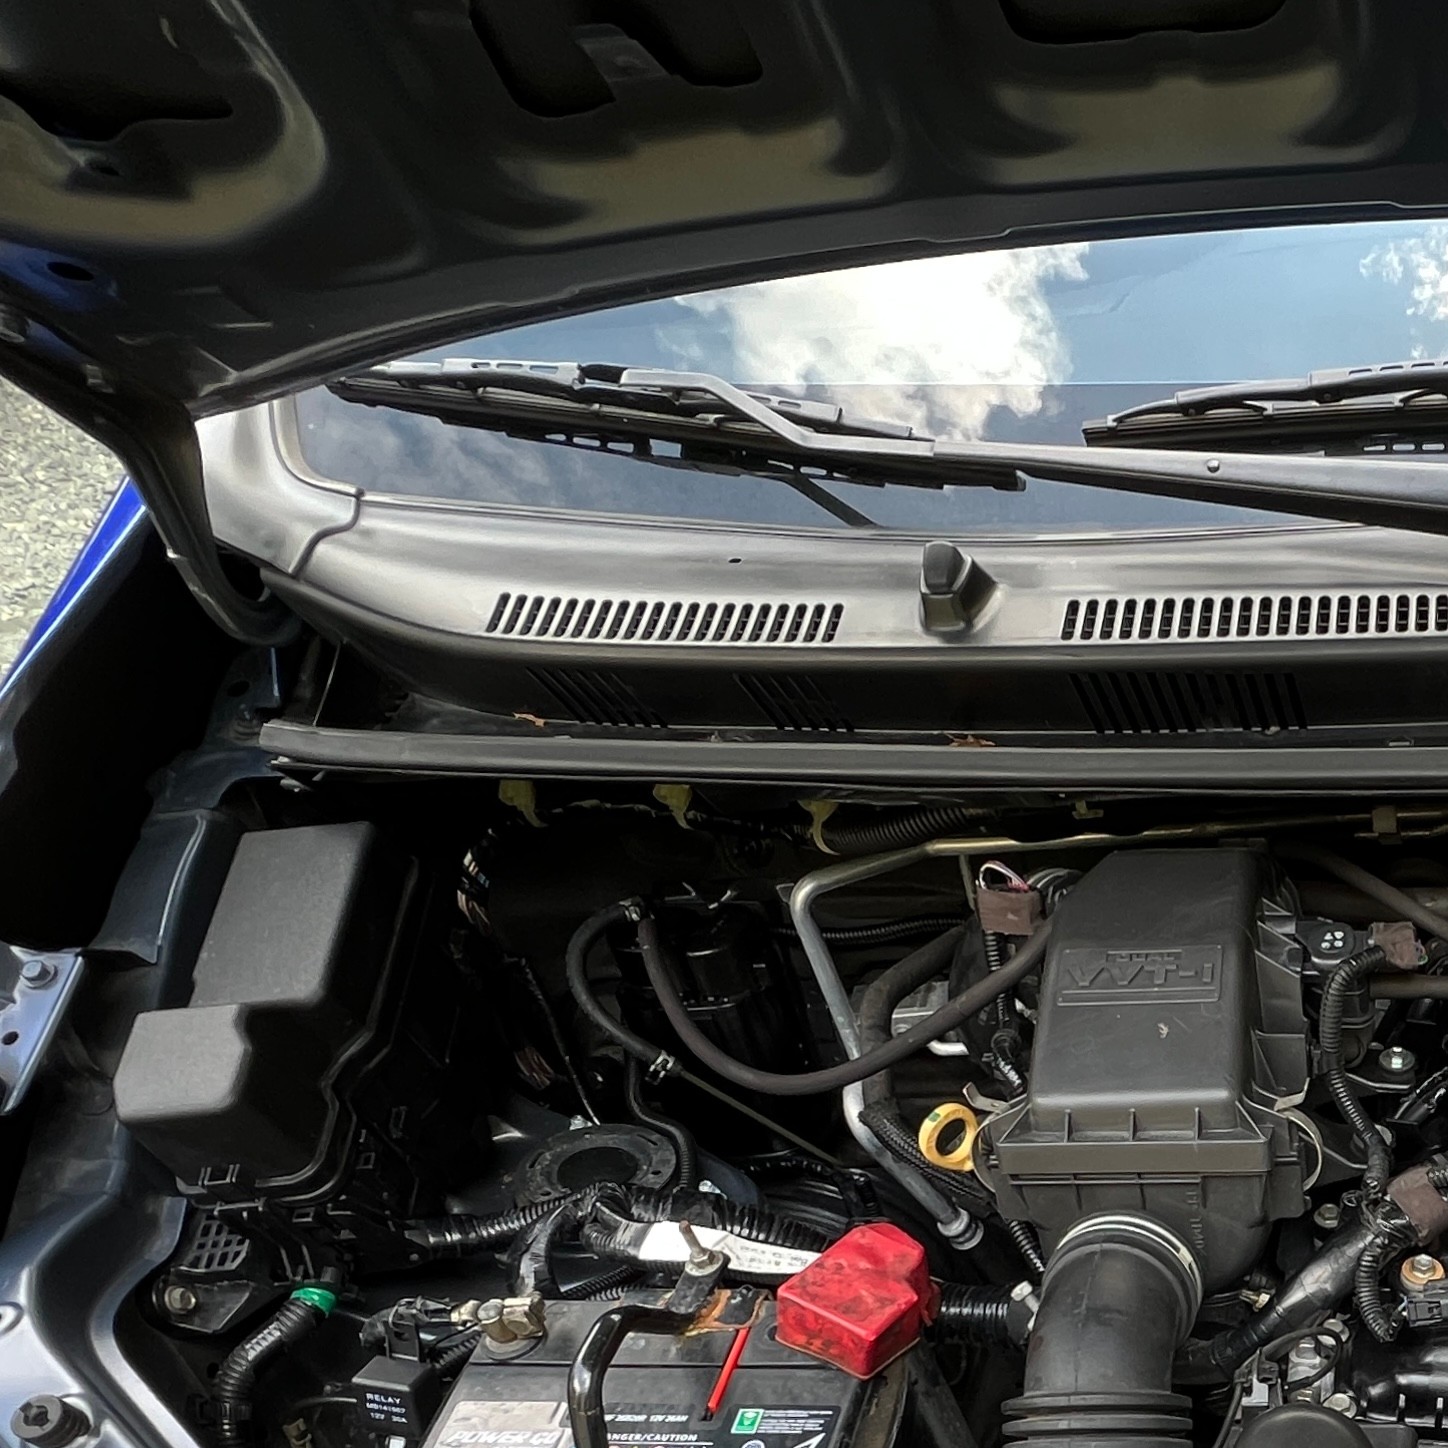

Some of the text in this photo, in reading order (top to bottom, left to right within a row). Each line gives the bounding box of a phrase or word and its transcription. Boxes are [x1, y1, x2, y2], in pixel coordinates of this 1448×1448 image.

[366, 1393, 401, 1404] RELAY
[448, 1431, 526, 1443] POWER
[607, 1433, 698, 1441] ANGER/CAUTION
